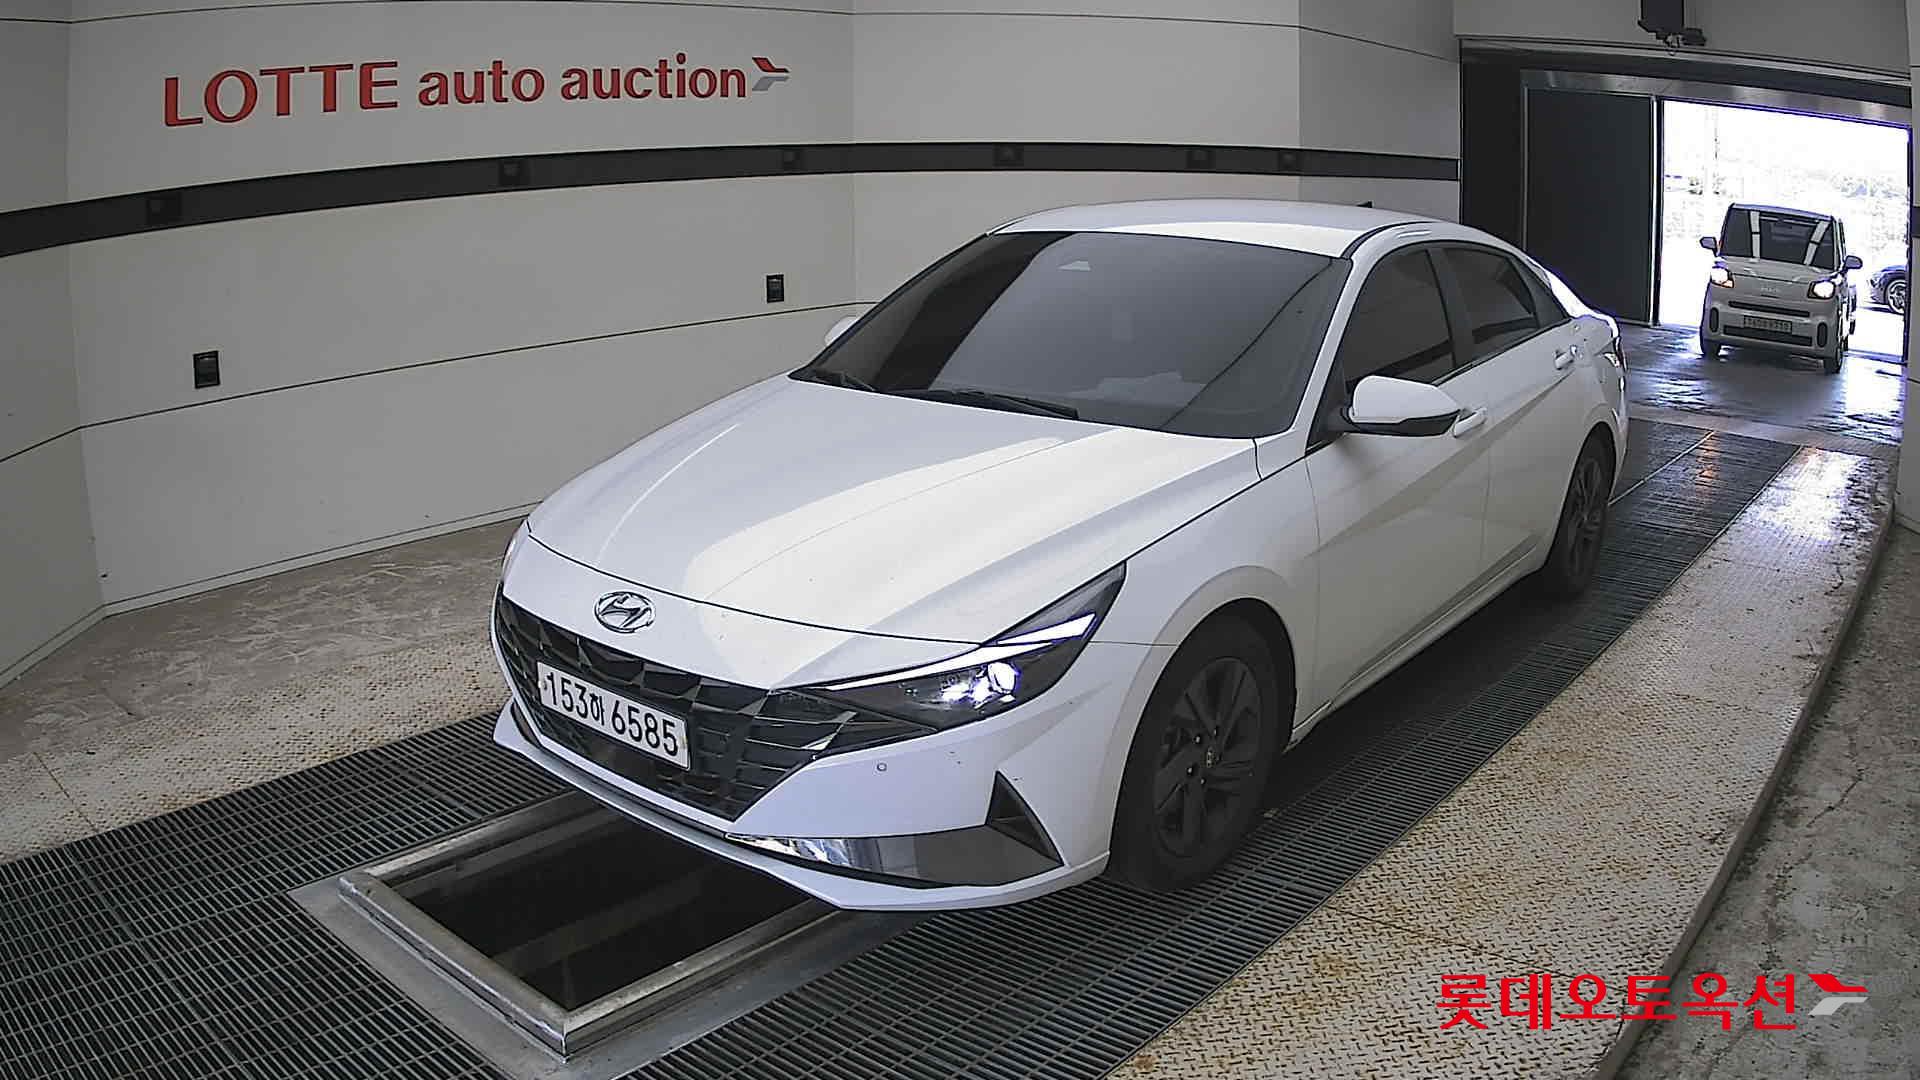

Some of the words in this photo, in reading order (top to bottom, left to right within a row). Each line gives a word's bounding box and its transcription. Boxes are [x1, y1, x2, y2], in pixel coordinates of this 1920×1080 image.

[163, 60, 399, 127] LOTTE
[418, 60, 545, 106] auto
[560, 52, 747, 99] auction
[611, 700, 679, 757] 6585
